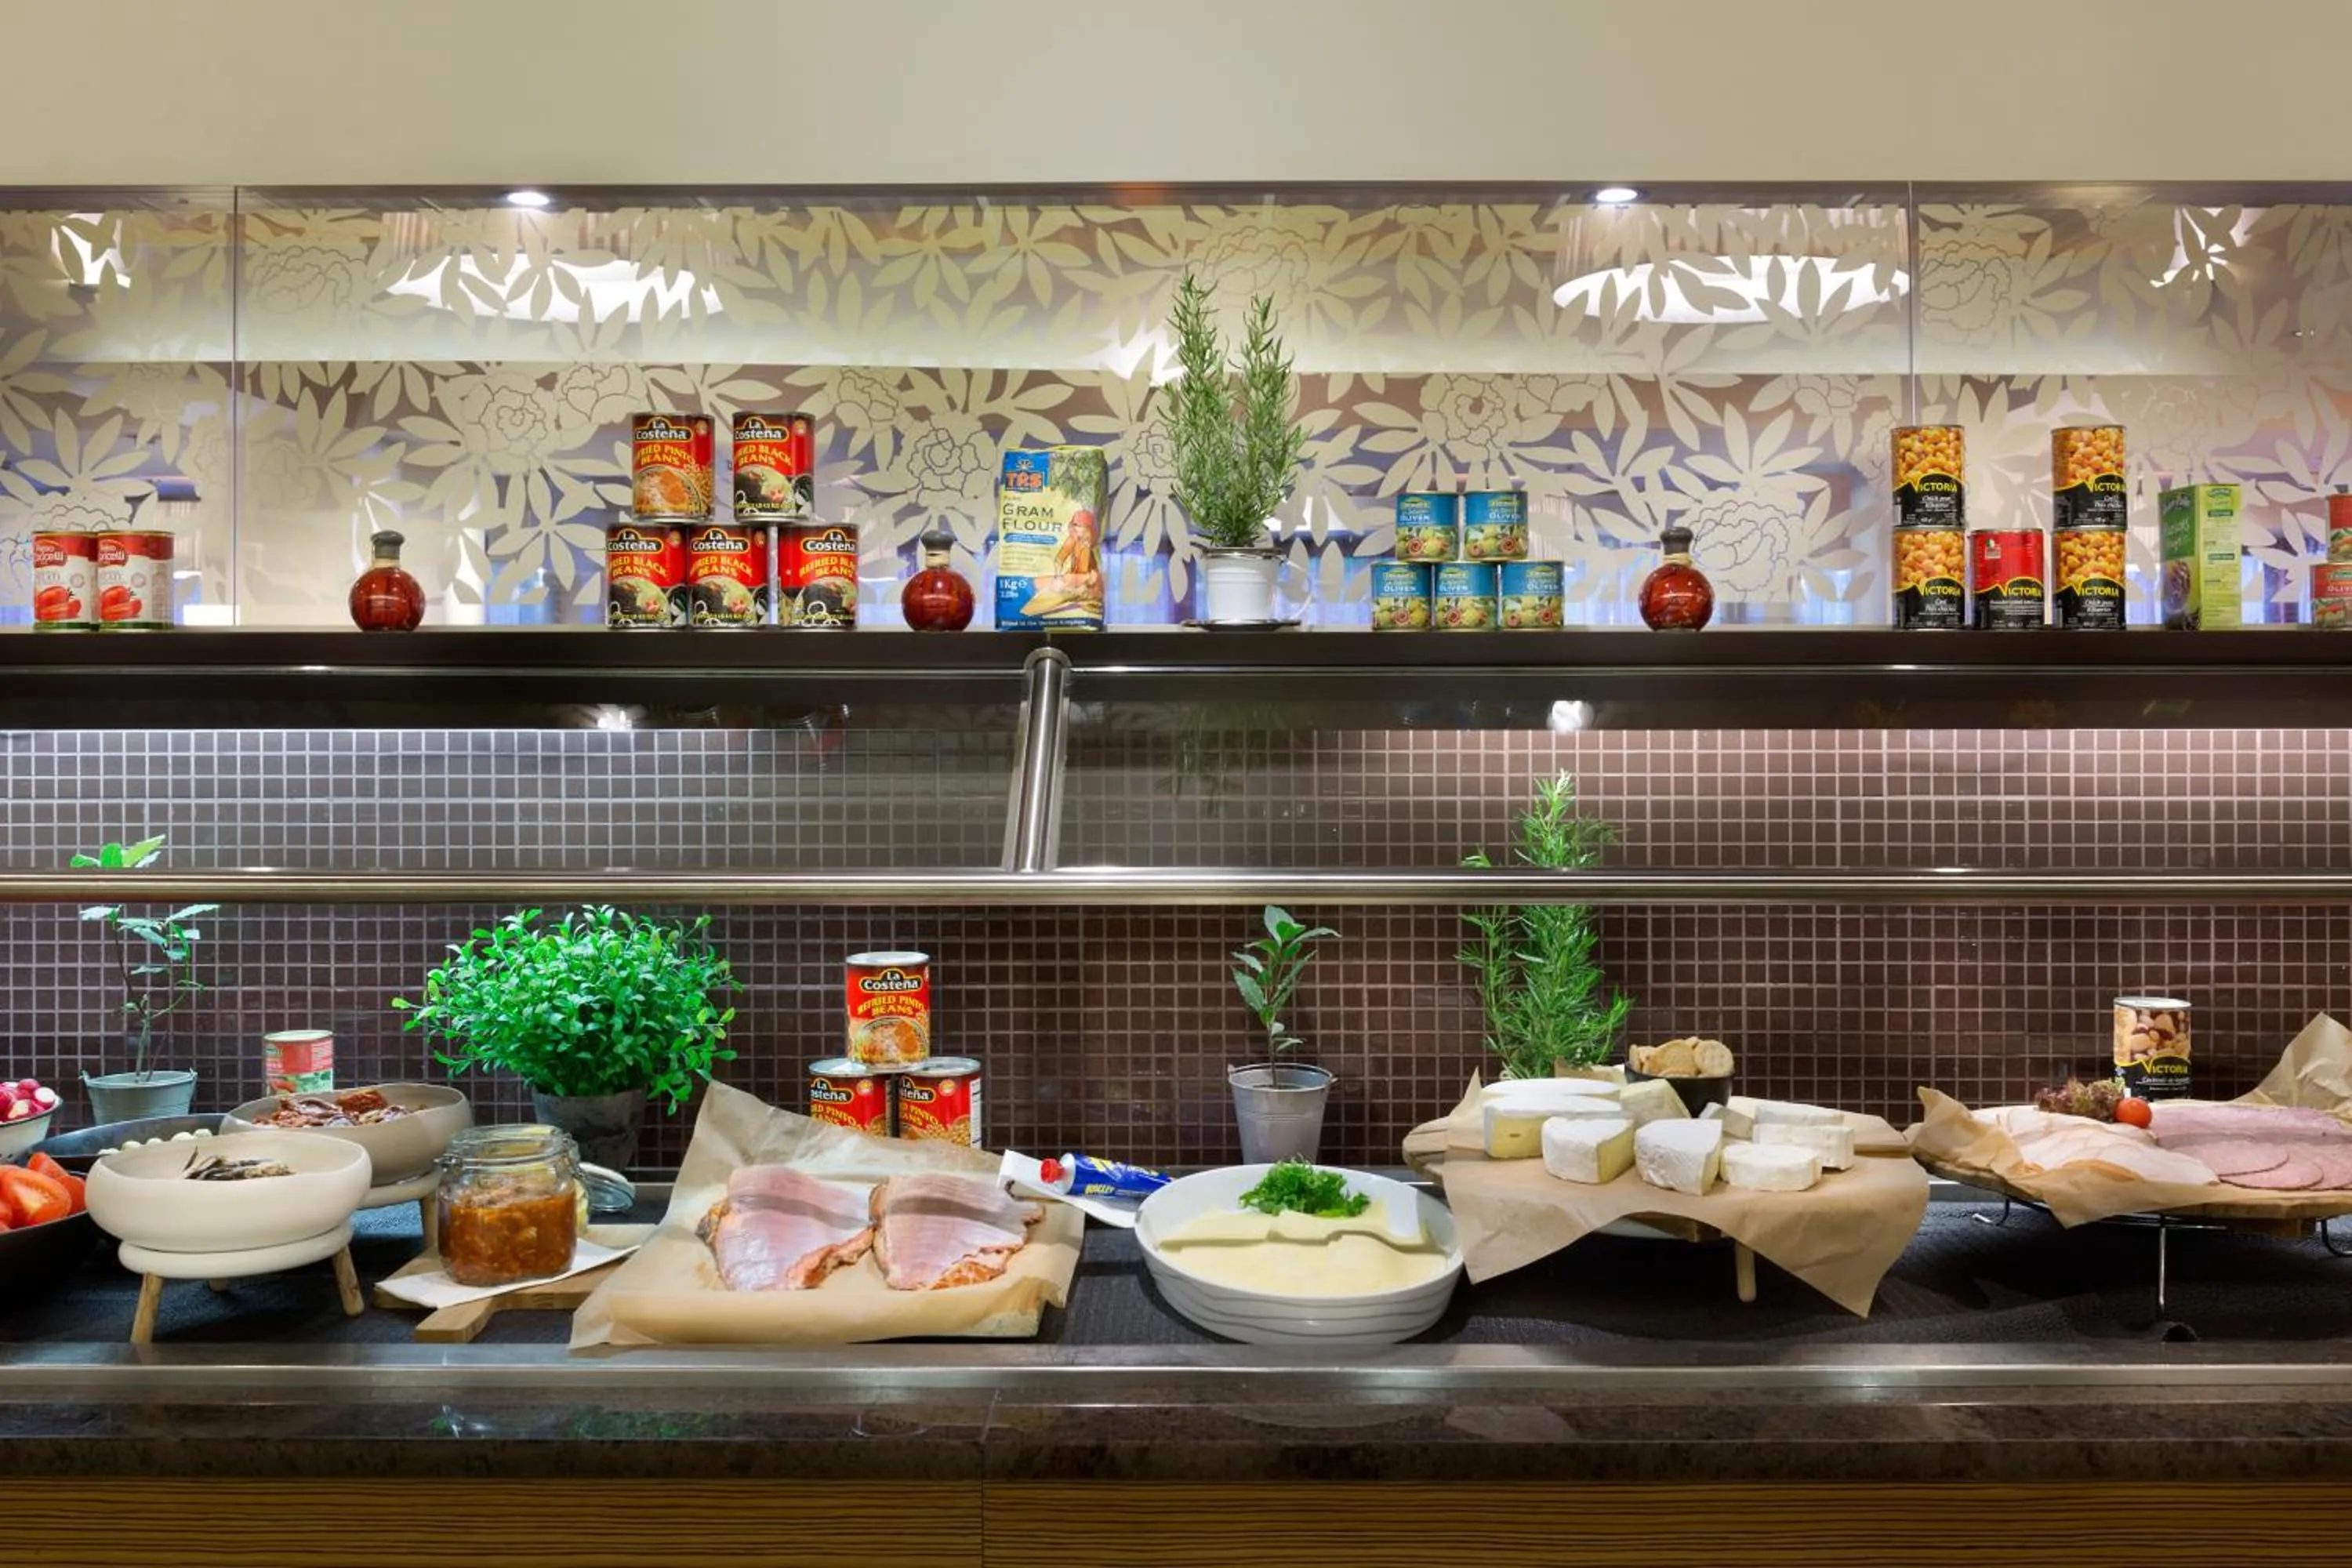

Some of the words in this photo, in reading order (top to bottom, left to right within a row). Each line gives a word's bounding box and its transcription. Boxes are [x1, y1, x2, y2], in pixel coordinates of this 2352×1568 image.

[652, 420, 666, 429] La
[750, 420, 761, 429] La
[1006, 472, 1043, 488] TRS
[1914, 481, 1958, 493] VICTORIA
[1003, 503, 1054, 517] GRAM
[1003, 517, 1062, 532] FLOUR
[710, 532, 722, 540] La
[887, 971, 901, 981] La
[872, 1005, 914, 1016] BEANS
[817, 1081, 827, 1090] La
